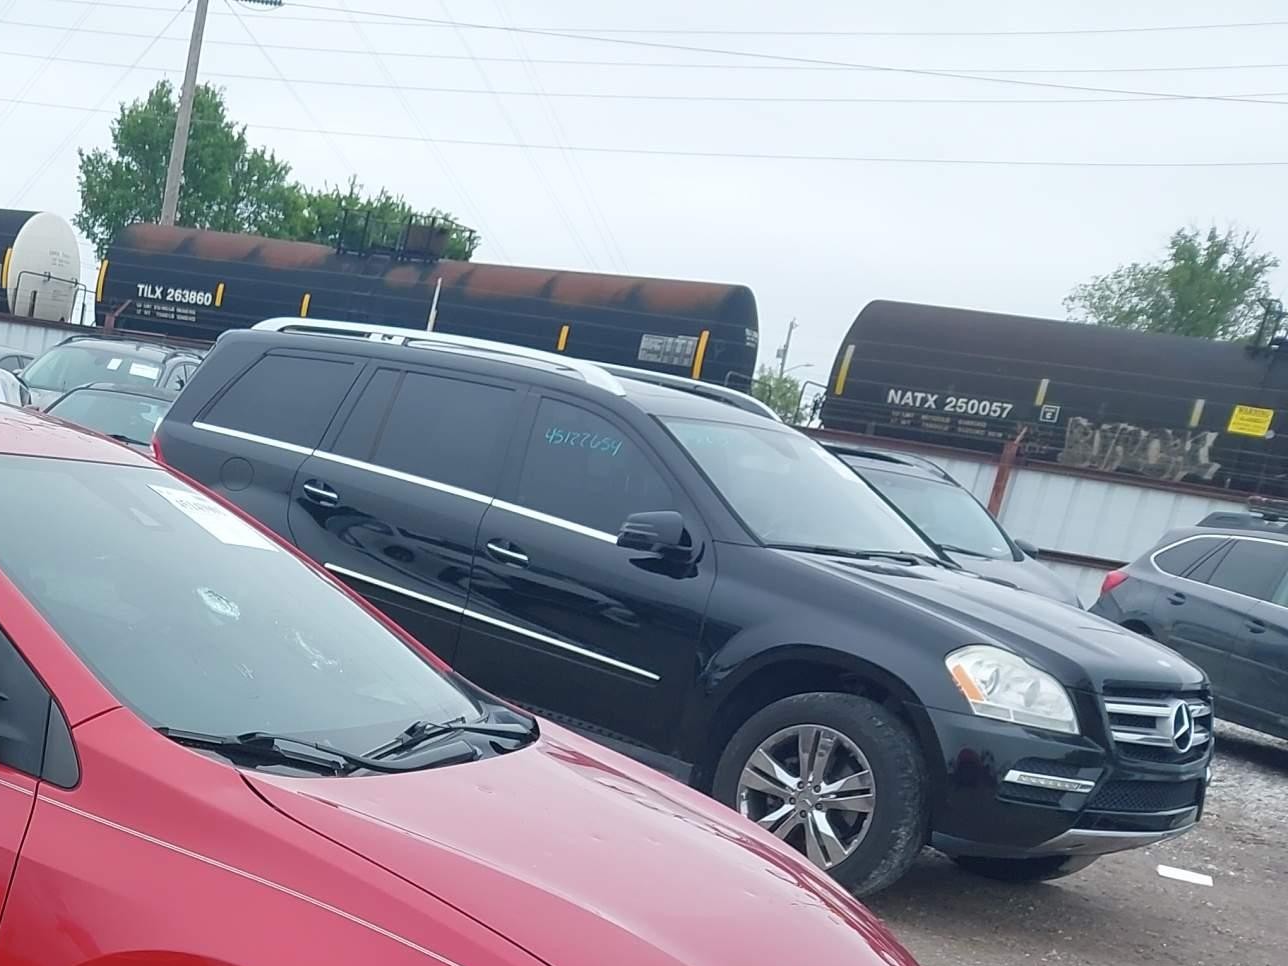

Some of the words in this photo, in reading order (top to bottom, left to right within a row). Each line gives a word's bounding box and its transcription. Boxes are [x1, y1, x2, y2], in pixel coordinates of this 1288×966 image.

[136, 283, 164, 300] TILX
[166, 288, 213, 306] 263860
[887, 389, 939, 409] NATX
[943, 396, 1013, 418] 250057
